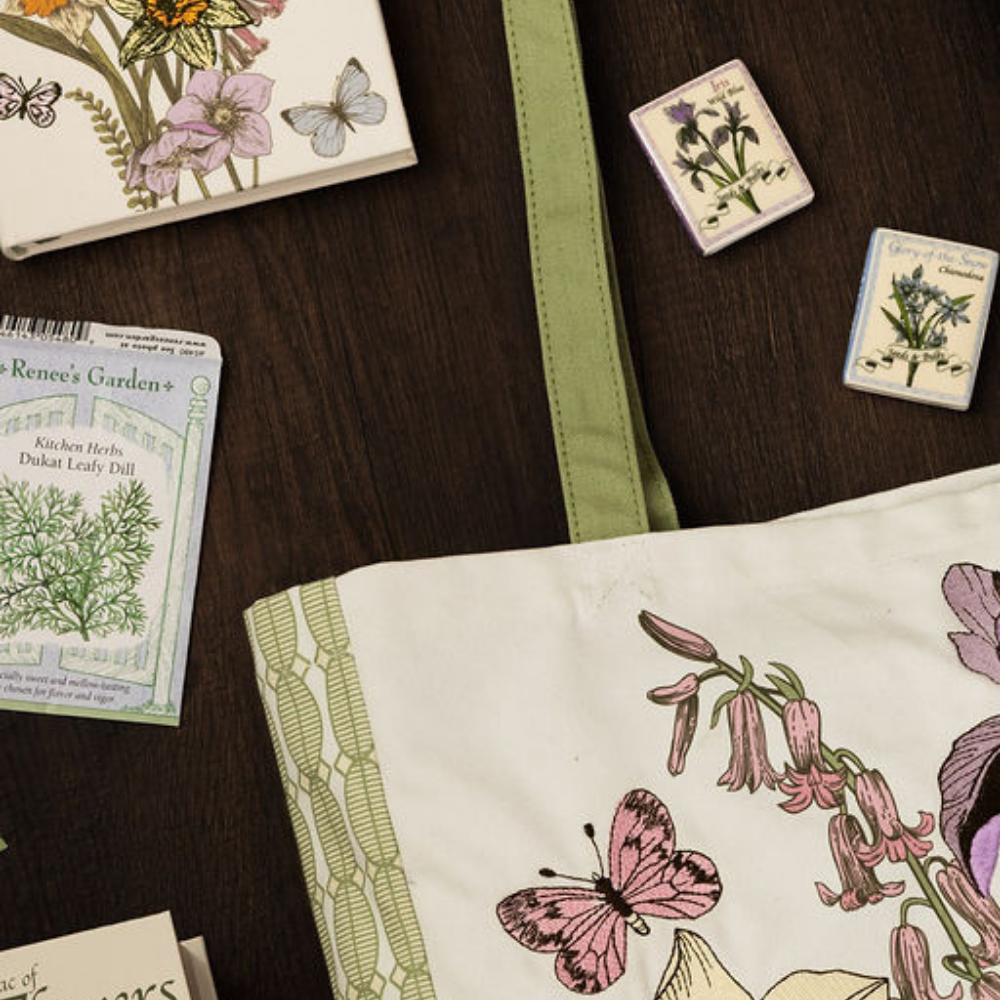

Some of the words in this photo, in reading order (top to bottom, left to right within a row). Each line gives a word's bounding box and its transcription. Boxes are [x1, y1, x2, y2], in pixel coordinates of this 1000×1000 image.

[11, 358, 80, 383] Renee's
[87, 366, 160, 392] Garden
[34, 436, 83, 453] Kitchen
[87, 441, 124, 457] Herbs
[19, 452, 62, 468] Dukat
[67, 457, 105, 476] Leafy
[109, 461, 135, 476] Dill
[22, 963, 39, 993] of
